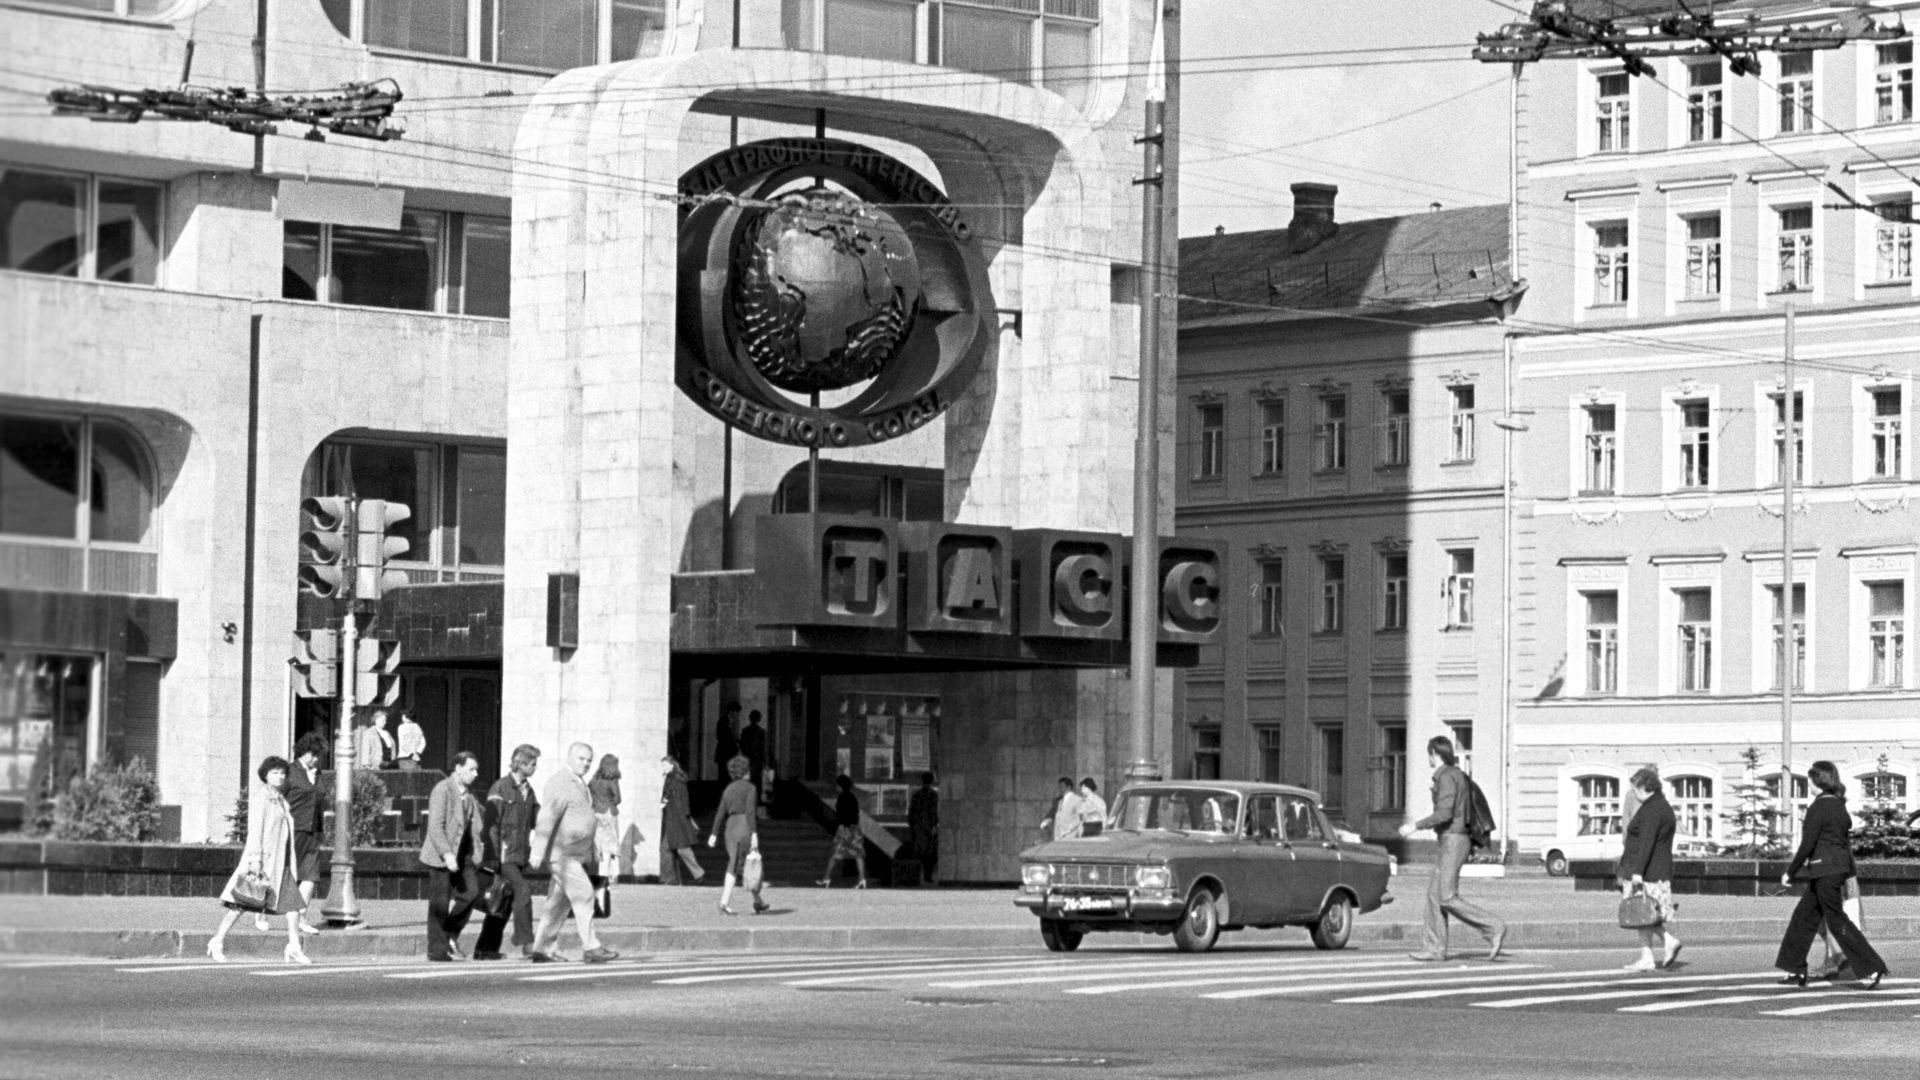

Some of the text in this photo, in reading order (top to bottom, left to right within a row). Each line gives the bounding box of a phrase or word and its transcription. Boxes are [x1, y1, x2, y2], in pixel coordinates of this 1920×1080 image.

[682, 139, 836, 198] ЕЛЕГРАФНОЕ
[692, 368, 849, 446] СОВЕТСКОГО
[829, 540, 1221, 631] ТАСС
